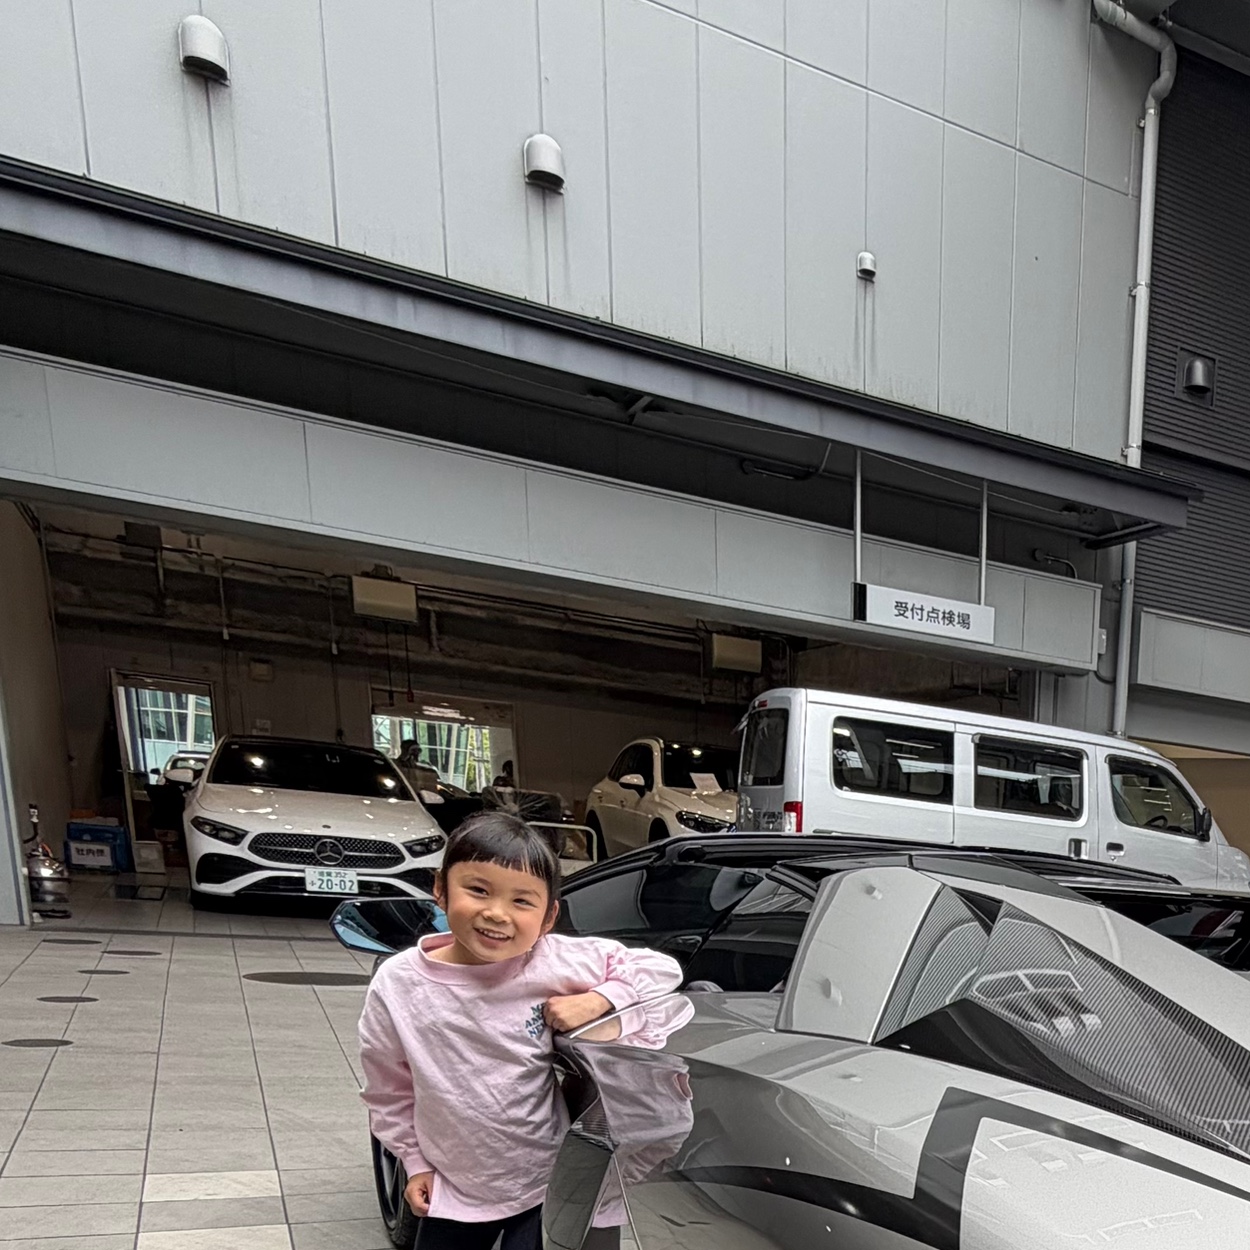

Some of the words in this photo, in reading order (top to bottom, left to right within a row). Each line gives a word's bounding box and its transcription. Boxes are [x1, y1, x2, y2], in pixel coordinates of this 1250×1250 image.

[894, 601, 971, 630] 受付点検場
[317, 878, 355, 891] 20-02
